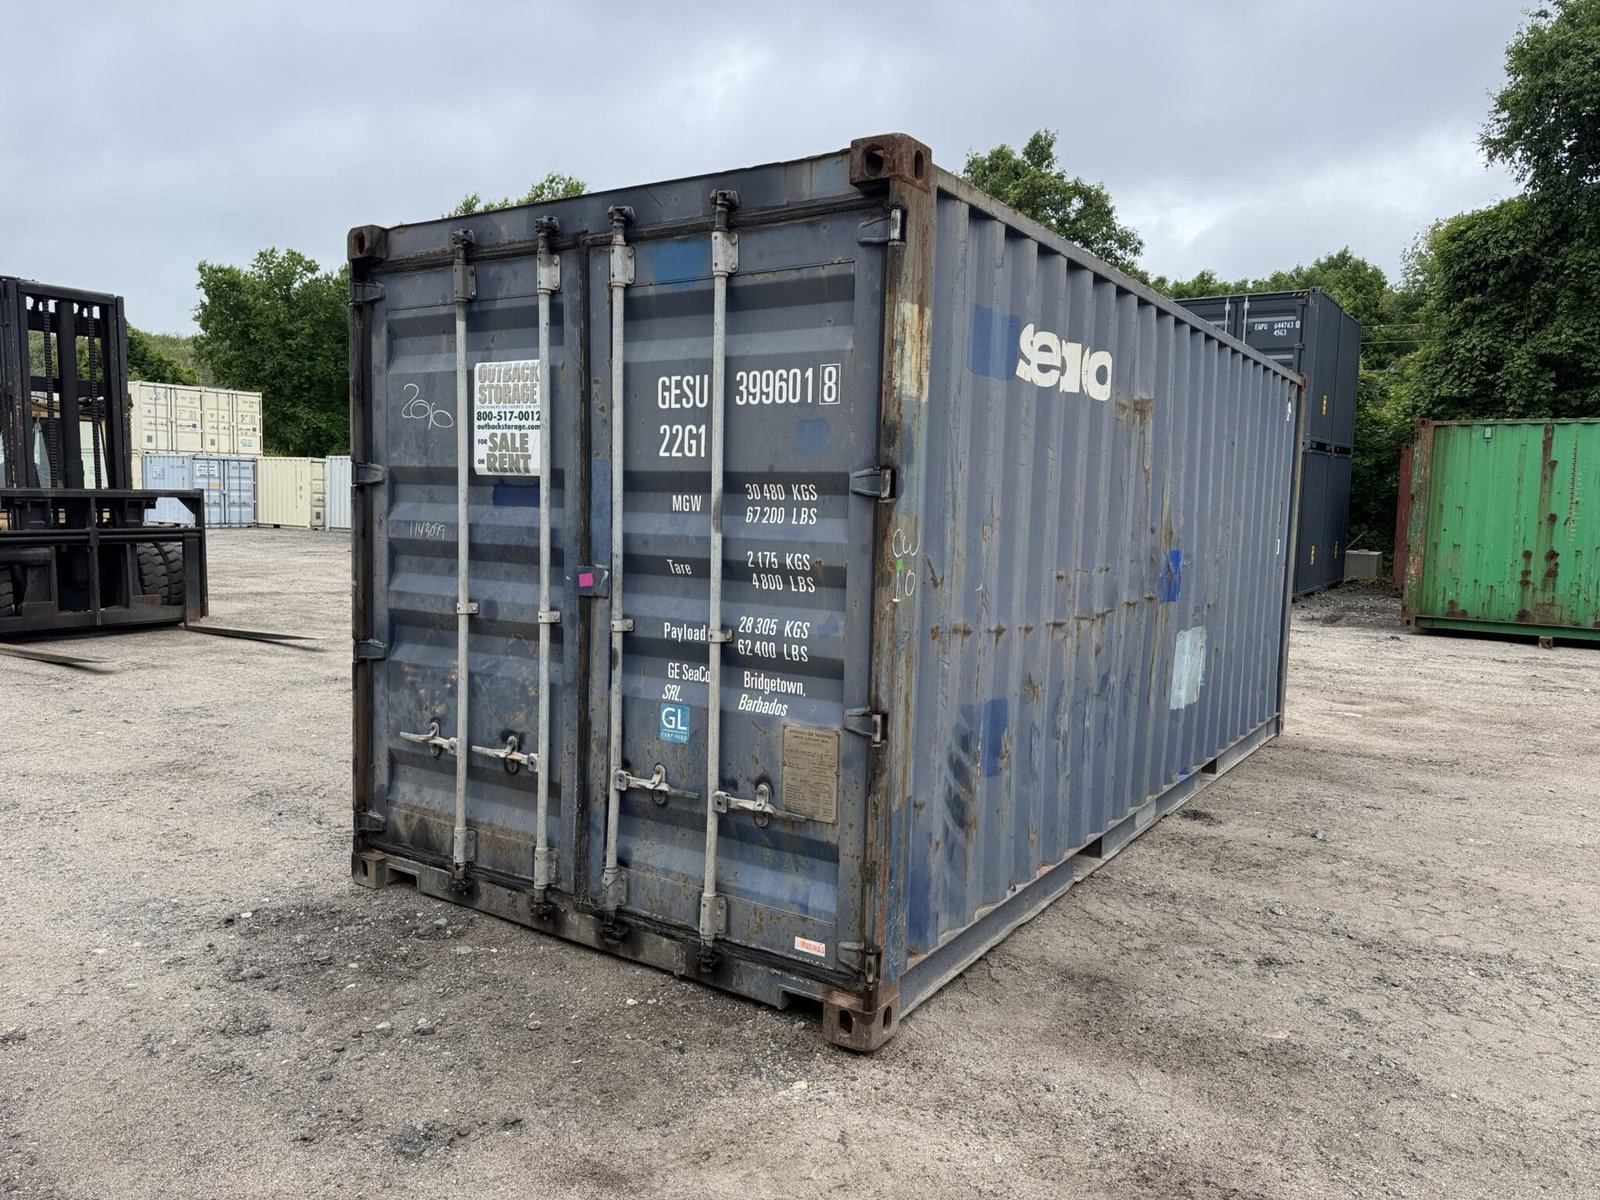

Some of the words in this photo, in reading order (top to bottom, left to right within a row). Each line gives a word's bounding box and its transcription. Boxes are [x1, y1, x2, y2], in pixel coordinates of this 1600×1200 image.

[478, 361, 540, 384] OUTBACK
[478, 383, 538, 405] STORAGE
[657, 374, 709, 409] GESU
[735, 367, 814, 406] 399601
[822, 365, 838, 403] 8
[476, 410, 540, 422] 800-517-0012
[477, 422, 540, 432] outbackstorage.com
[488, 432, 529, 453] SALE
[658, 424, 707, 458] 22G1
[486, 452, 532, 474] RENT
[791, 483, 818, 502] KGS
[672, 494, 702, 512] MGW
[791, 507, 817, 525] LBS
[666, 558, 693, 575] Tare
[785, 552, 811, 571] KGS
[789, 575, 816, 593] LBS
[664, 622, 706, 643] Payload
[784, 619, 811, 640] KGS
[783, 643, 809, 663] LBS
[667, 662, 681, 680] GE
[662, 683, 684, 702] SRL.
[744, 670, 807, 697] Bridgetown,
[738, 693, 788, 717] Barbados
[661, 706, 688, 731] GL
